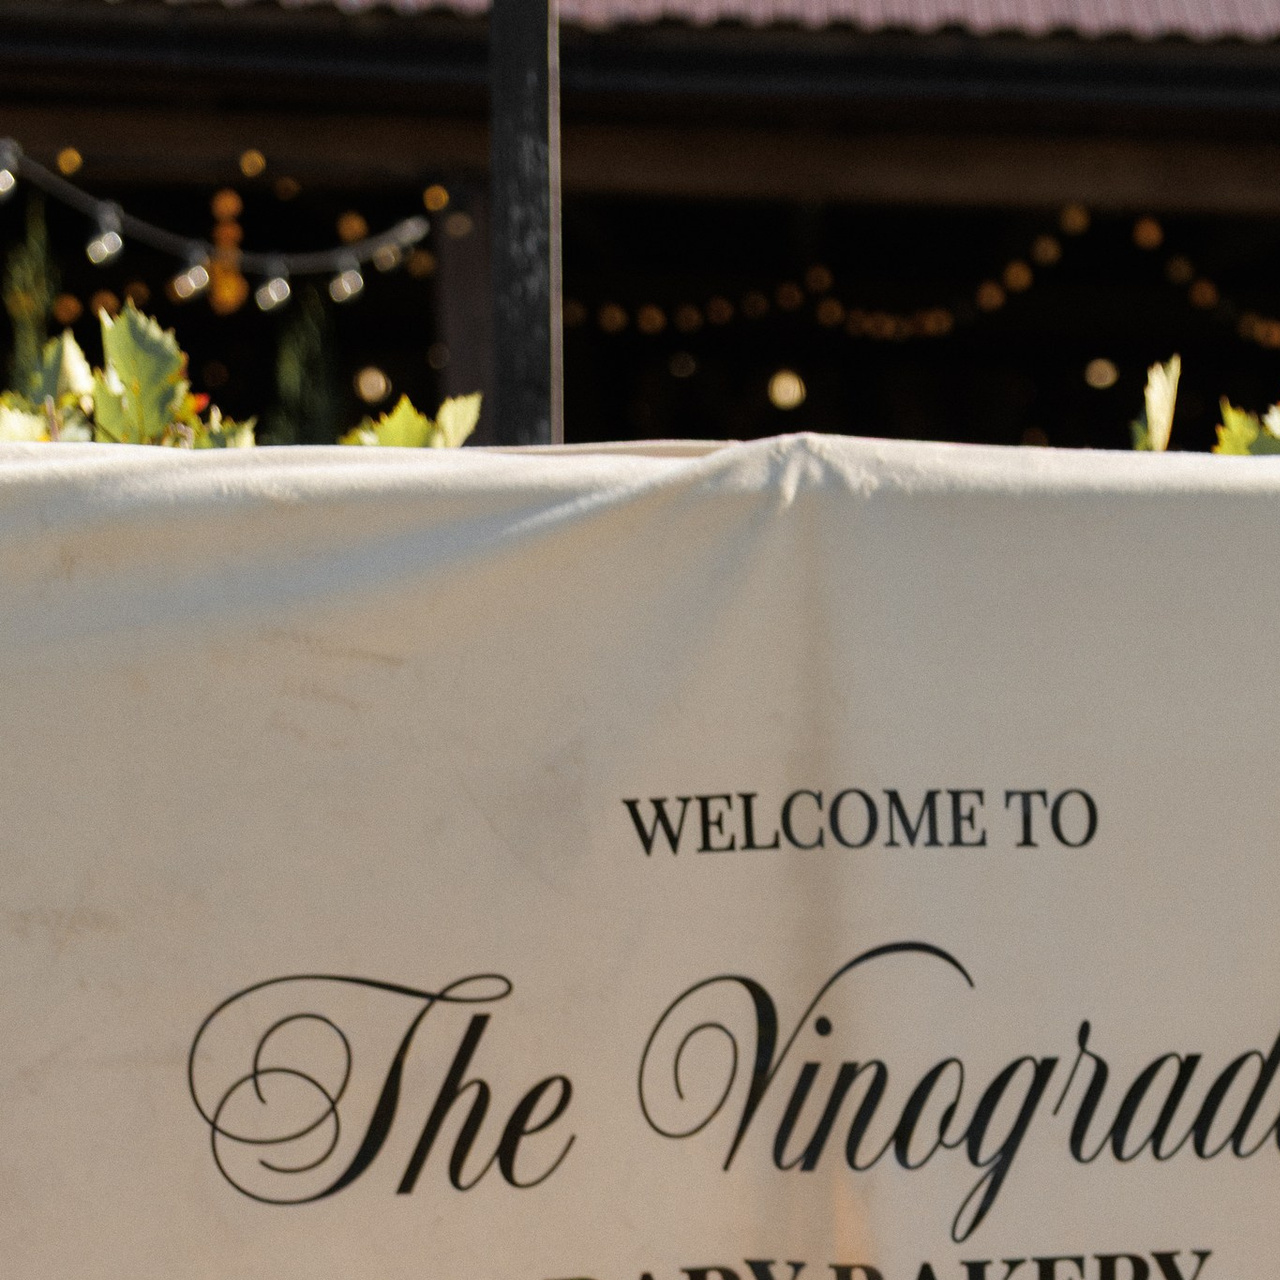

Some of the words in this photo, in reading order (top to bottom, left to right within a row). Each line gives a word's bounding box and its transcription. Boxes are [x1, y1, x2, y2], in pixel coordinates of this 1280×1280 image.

[620, 786, 988, 858] WELCOME
[1003, 787, 1100, 850] TO
[186, 971, 579, 1208] The
